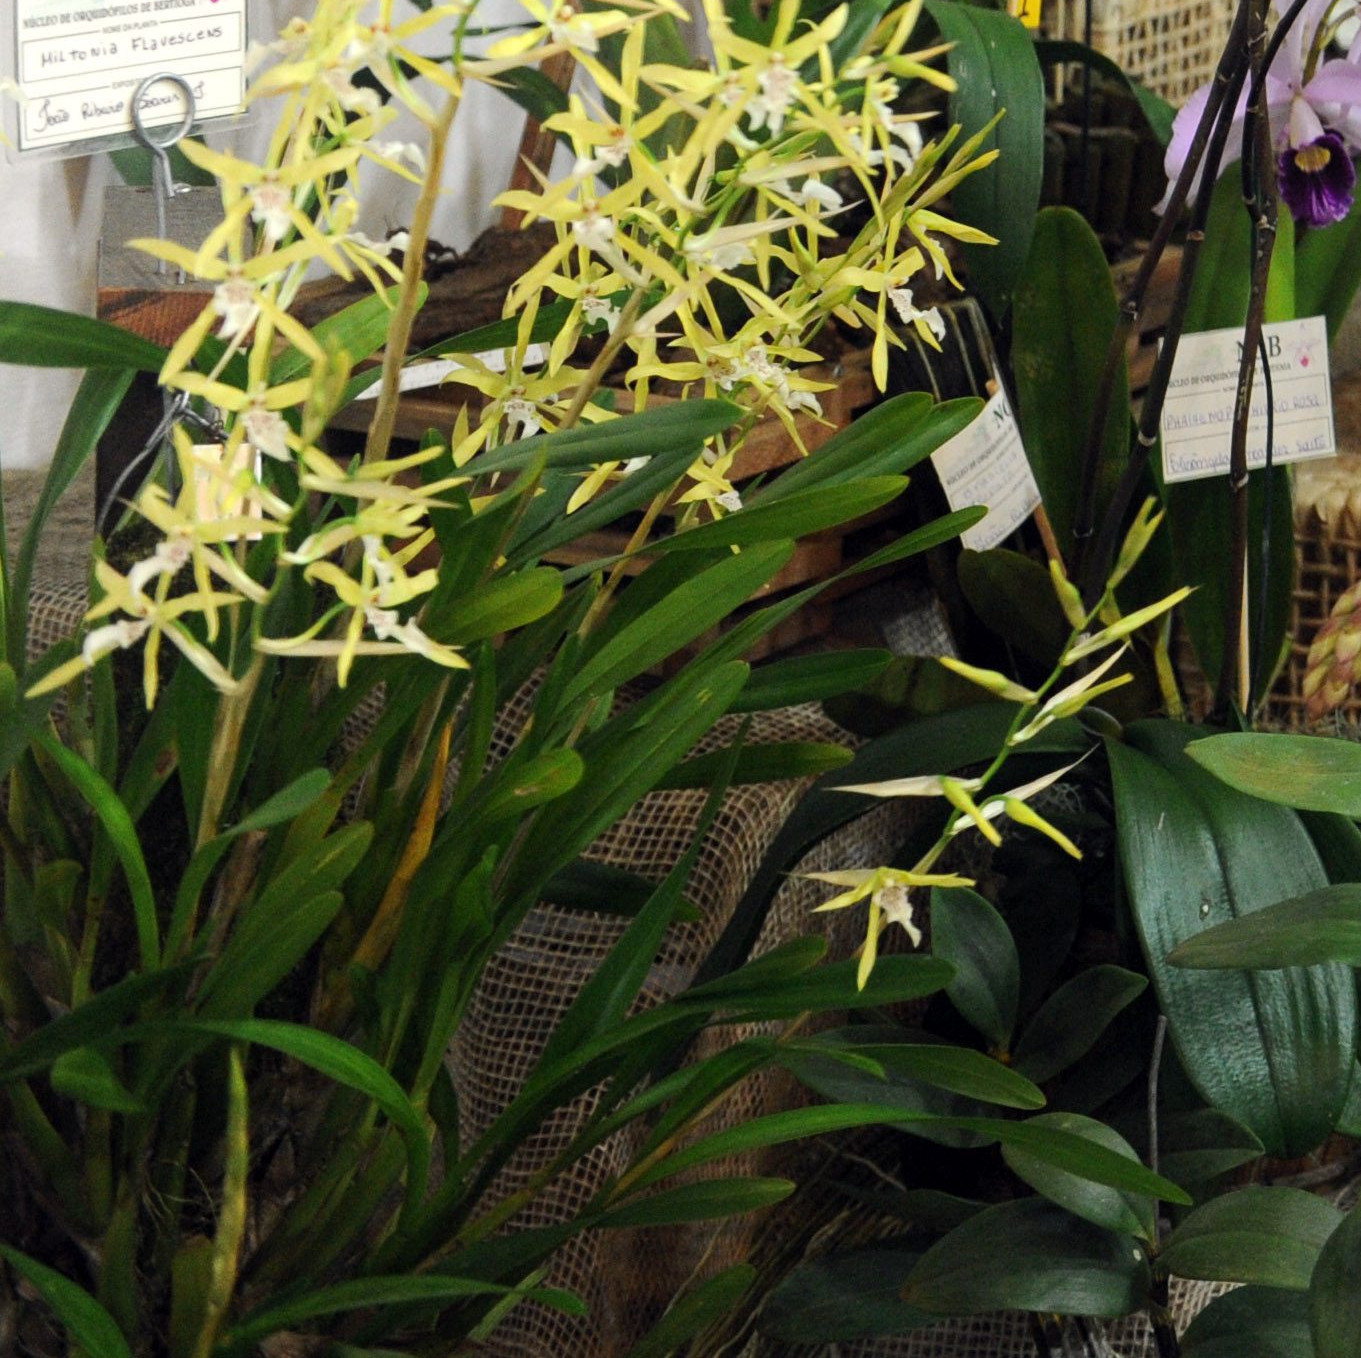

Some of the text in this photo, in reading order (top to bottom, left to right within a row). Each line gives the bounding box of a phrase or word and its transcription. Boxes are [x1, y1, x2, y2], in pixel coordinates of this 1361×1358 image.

[23, 14, 58, 30] NÚCLEO
[60, 12, 71, 24] DE
[72, 3, 138, 23] ORQUIDÓFILOS
[140, 1, 151, 13] DE
